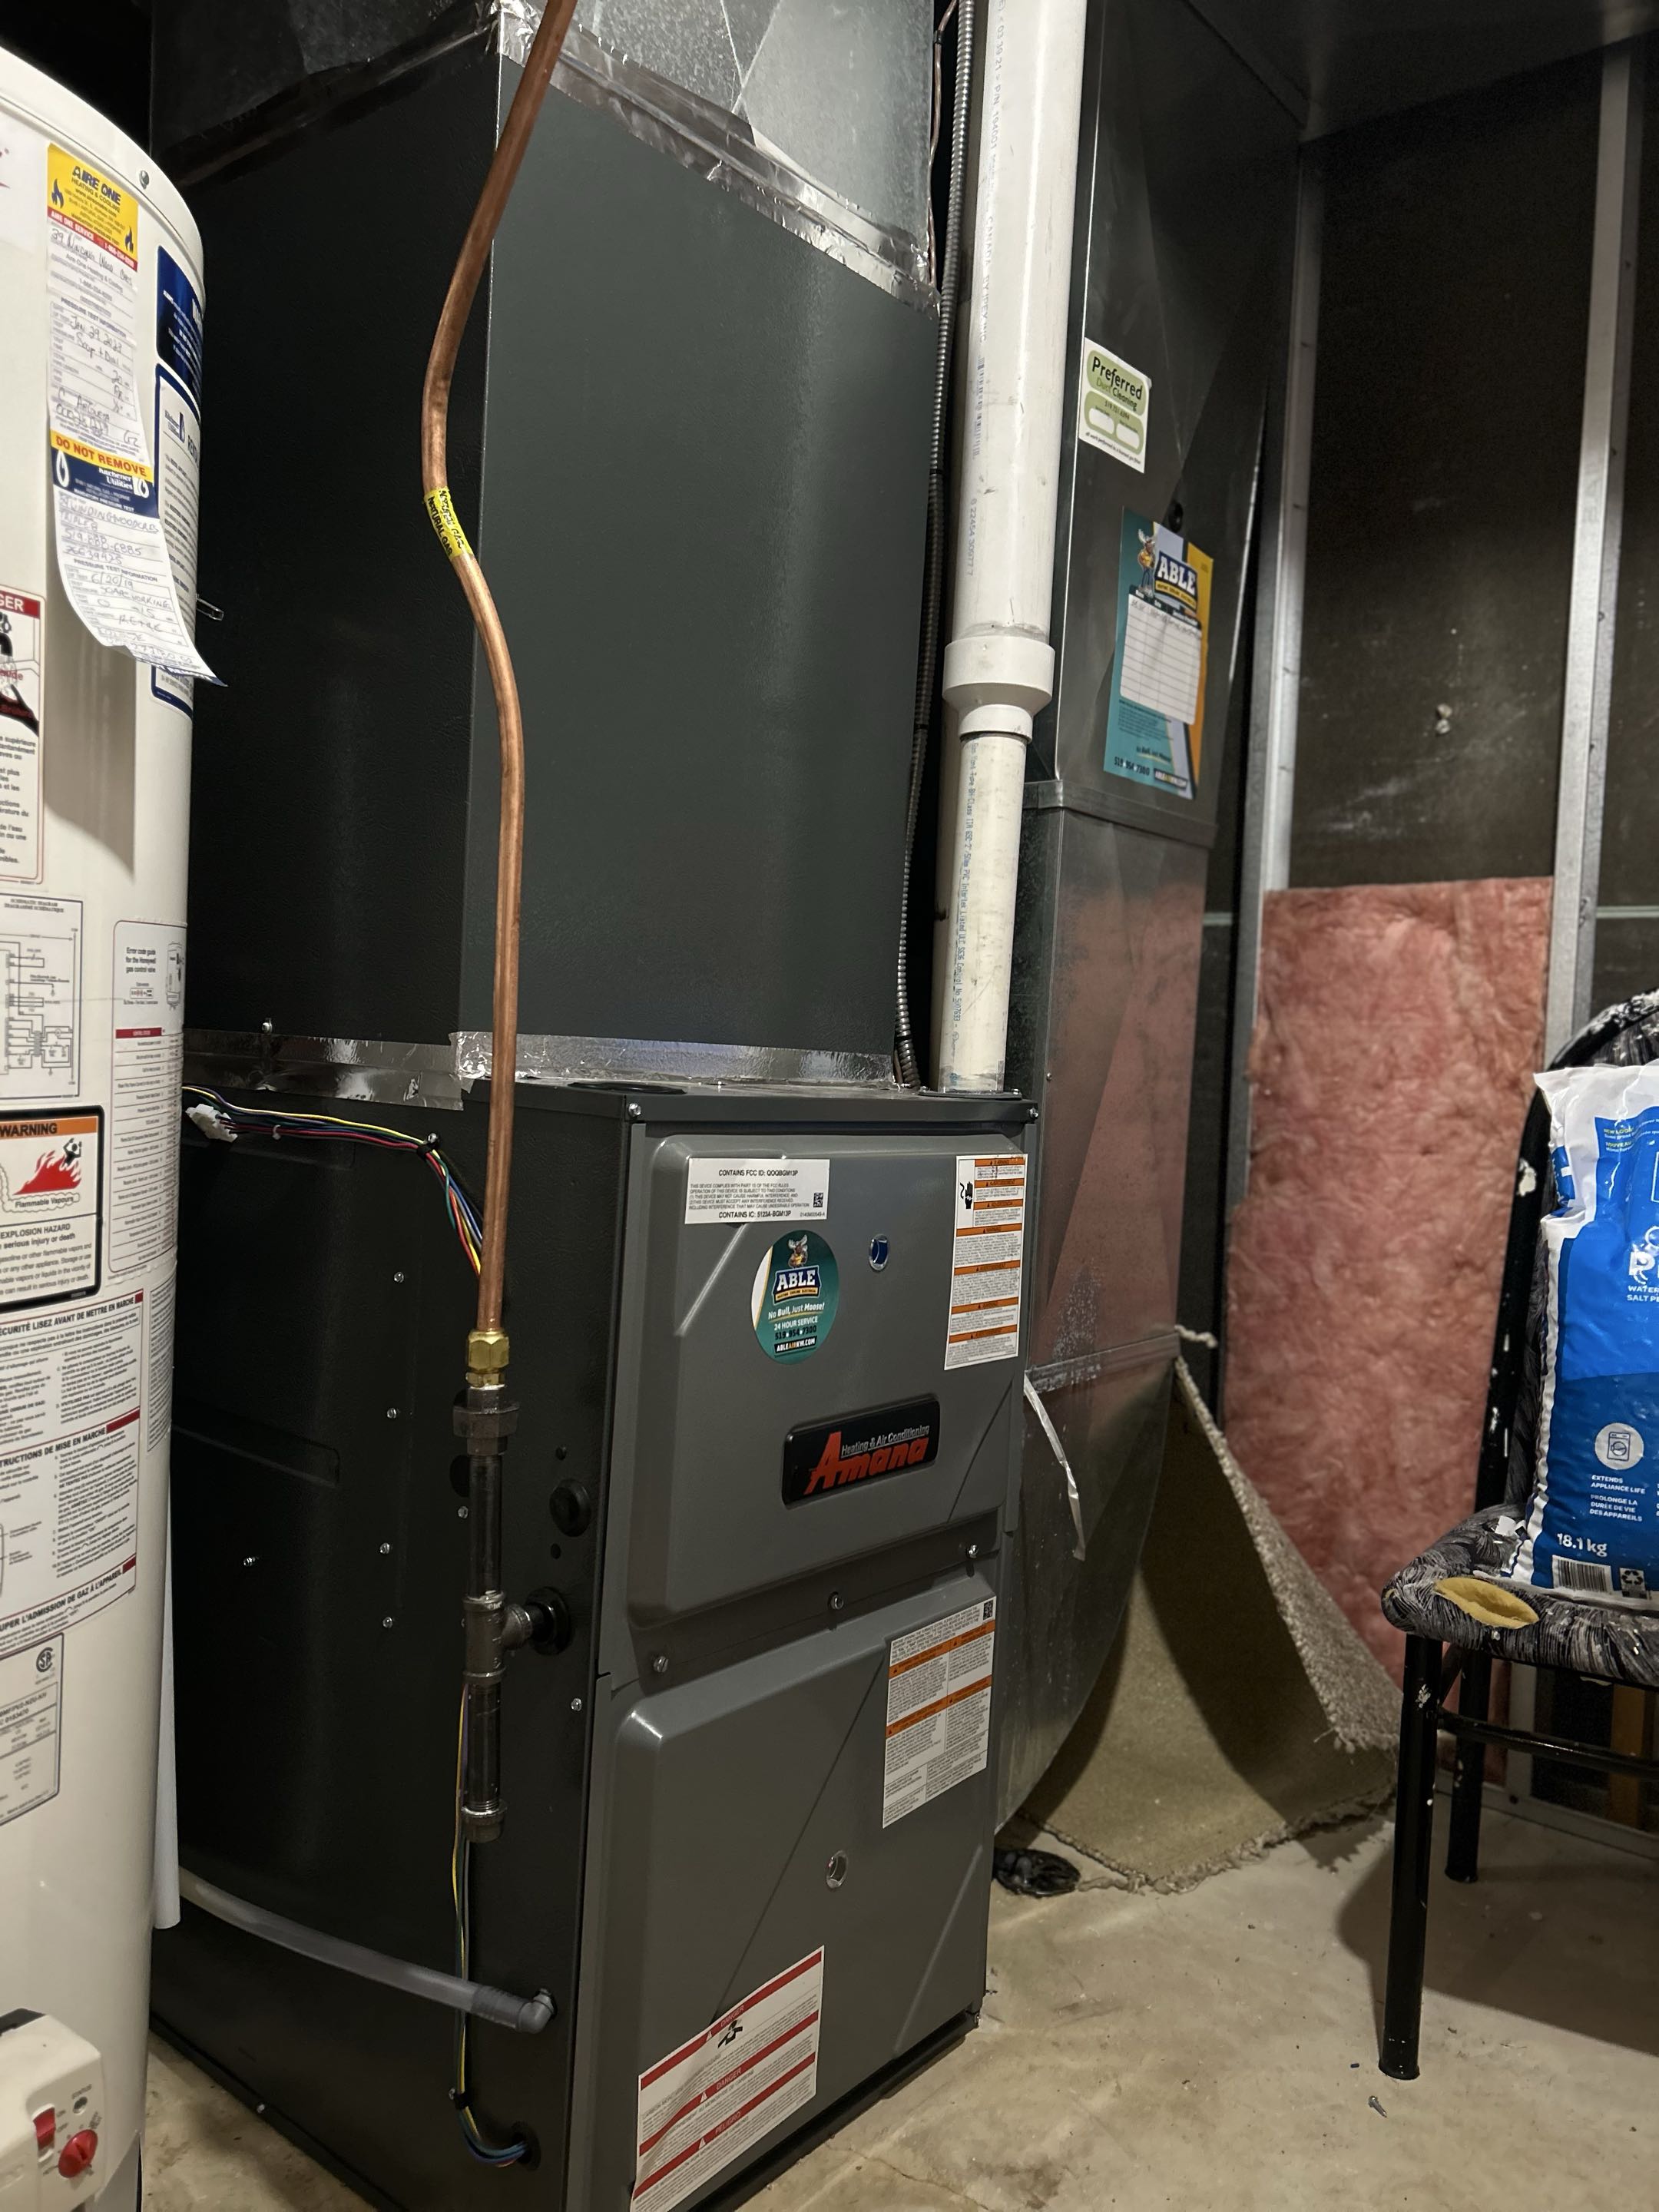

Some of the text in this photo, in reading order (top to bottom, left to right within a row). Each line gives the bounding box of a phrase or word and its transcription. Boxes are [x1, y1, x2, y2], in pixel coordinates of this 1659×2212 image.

[71, 177, 94, 196] HEATING
[99, 194, 121, 213] COOLING
[72, 165, 121, 206] AIRE ONE
[1091, 356, 1143, 400] Preferred
[1096, 376, 1111, 394] Duct
[1112, 387, 1137, 412] Cleaning
[56, 435, 70, 452] DO
[74, 445, 94, 460] NOT
[98, 453, 147, 477] REMOVE
[106, 476, 134, 490] Utilities
[428, 496, 453, 555] NATURAL GAS
[1157, 555, 1196, 595] ABLE
[962, 869, 971, 880] PVC
[960, 882, 969, 908] Intertek
[959, 911, 968, 932] Listed
[955, 962, 965, 985] Control
[0, 1122, 58, 1137] WARNING
[15, 1196, 75, 1209] Flammable Vapours
[1, 1224, 71, 1240] EXPLOSION HAZARD
[3, 1239, 29, 1250] serious
[31, 1236, 50, 1248] injury
[58, 1231, 75, 1241] death
[20, 1262, 34, 1270] other
[16, 1283, 31, 1292] result
[777, 1271, 816, 1292] ABLE
[1628, 1285, 1659, 1293] WATER
[32, 1297, 134, 1330] LISEZ AVANT DE METTRE EN MARCHE
[768, 1302, 825, 1320] No Bull, Just Moose!
[781, 1320, 796, 1330] HOUR
[797, 1316, 818, 1326] SERVICE
[777, 1337, 816, 1352] ABLEAIRKW.COM
[45, 1445, 54, 1455] DE
[55, 1439, 71, 1453] MISE
[72, 1435, 81, 1445] EN
[82, 1428, 105, 1442] MARCHE
[842, 1425, 929, 1456] Heating & Air Conditioning
[803, 1431, 929, 1495] Amana
[1591, 1475, 1623, 1483] EXTENDS
[1591, 1482, 1629, 1492] APPLIANCE
[1591, 1494, 1628, 1504] PROLONGE
[1591, 1501, 1612, 1510] DURÉE
[1603, 1511, 1643, 1522] APPAREILS
[1557, 1532, 1608, 1558] 18.1 kg
[22, 1600, 66, 1624] L'ADMISSION
[67, 1594, 76, 1604] DE
[77, 1588, 89, 1601] GAZ
[95, 1570, 121, 1591] L'APPAREIL
[720, 2005, 745, 2027] DANGER
[716, 2068, 742, 2090] DANGER
[715, 2111, 742, 2135] PELIGRO
